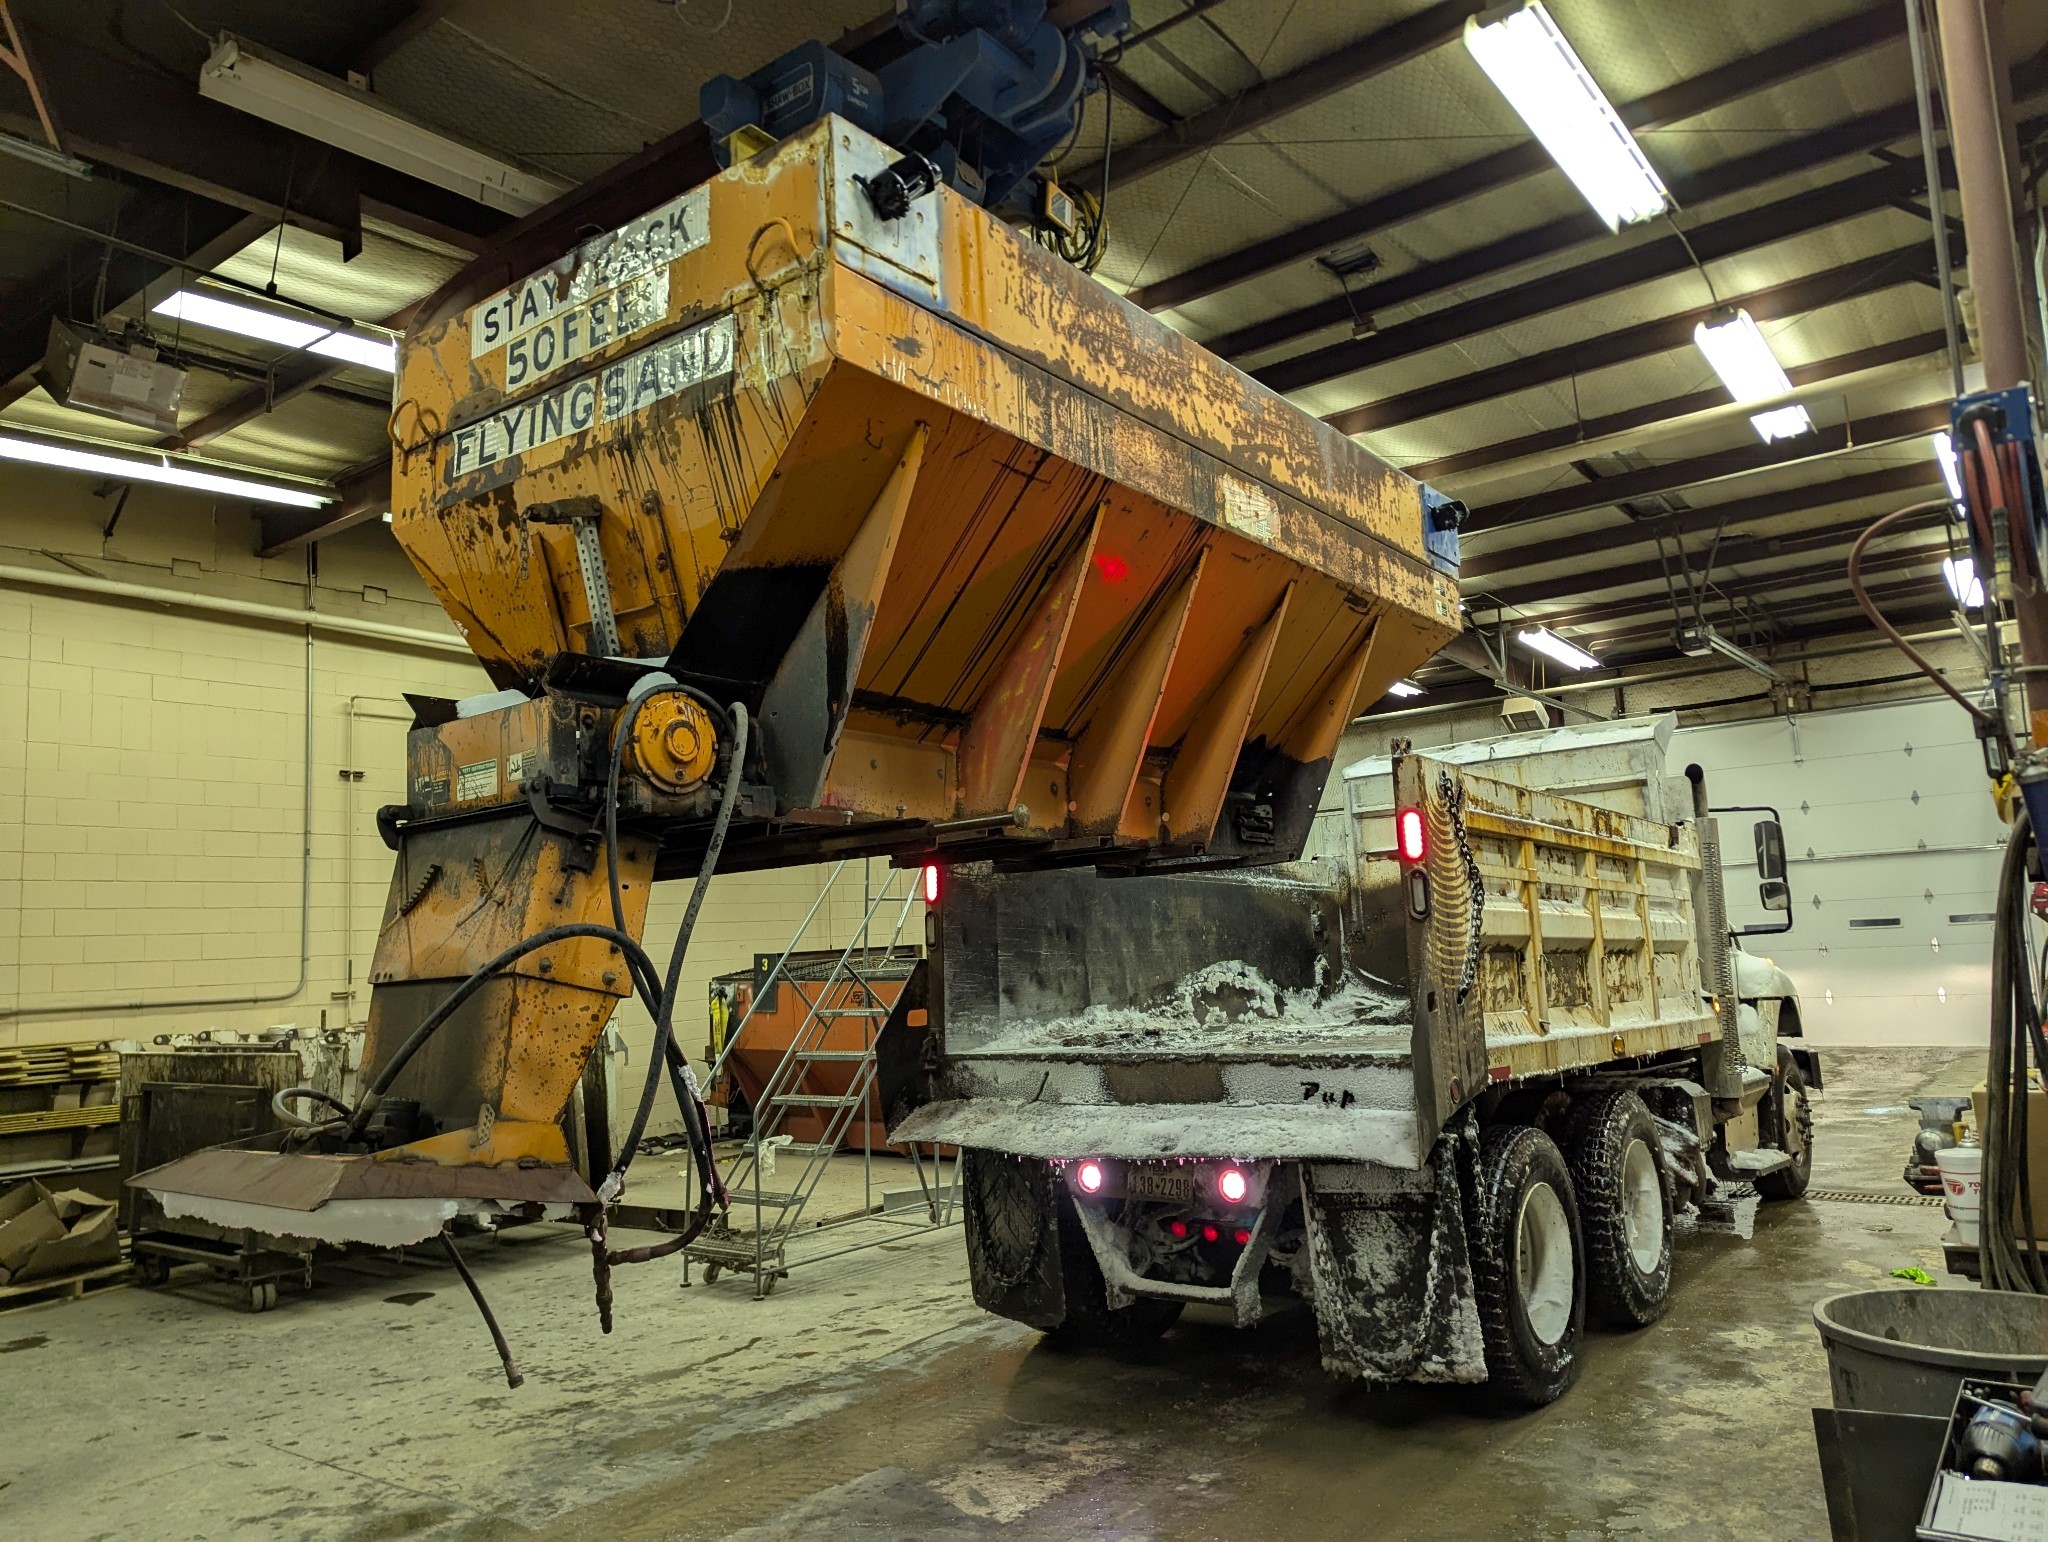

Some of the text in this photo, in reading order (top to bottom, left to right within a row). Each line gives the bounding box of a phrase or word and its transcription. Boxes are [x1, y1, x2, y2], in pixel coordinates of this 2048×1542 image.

[851, 77, 860, 95] 5
[484, 278, 558, 343] STAY
[563, 279, 662, 359] FEE
[761, 958, 769, 971] 3
